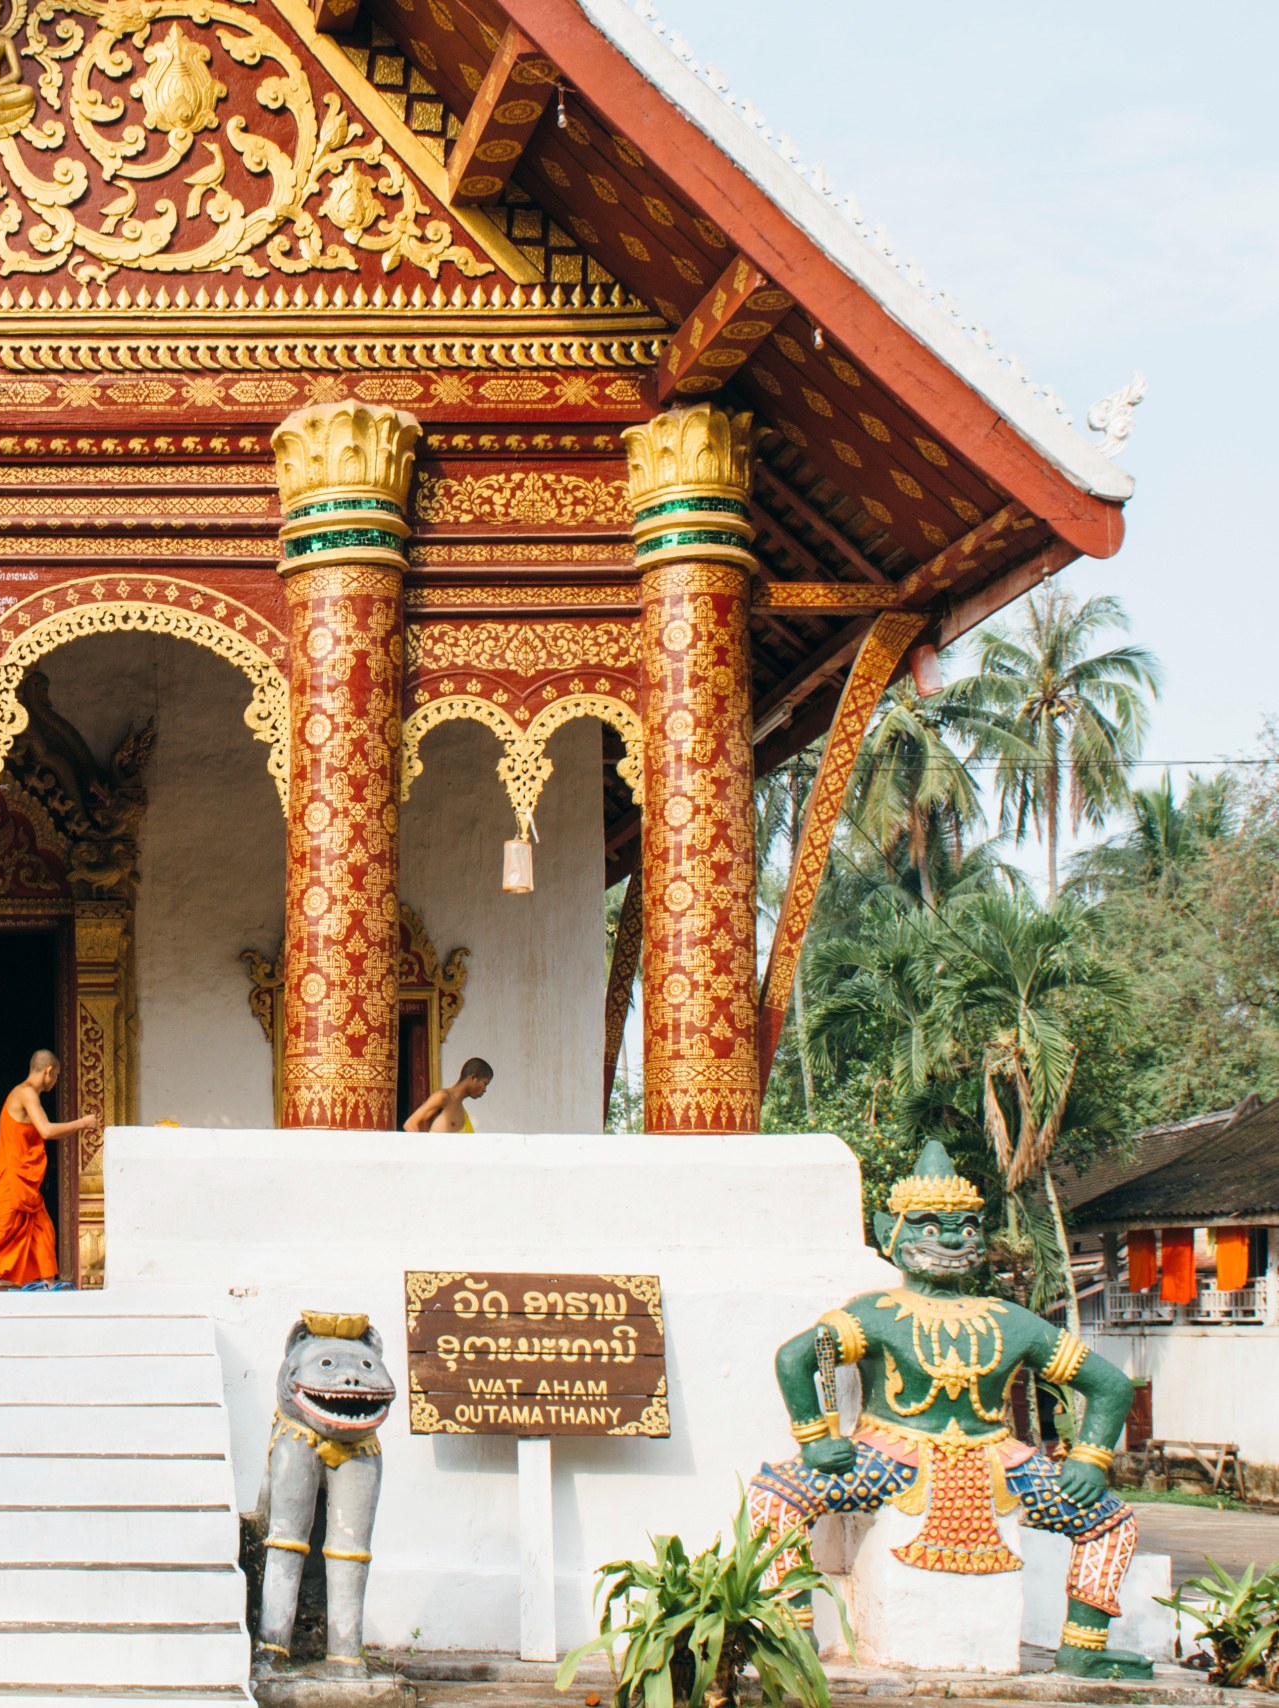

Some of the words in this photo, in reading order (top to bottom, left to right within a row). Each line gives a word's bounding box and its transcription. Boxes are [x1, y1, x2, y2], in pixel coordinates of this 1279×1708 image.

[453, 1277, 509, 1320] ວັດ
[468, 1378, 523, 1400] WAT
[536, 1380, 608, 1401] AHAM
